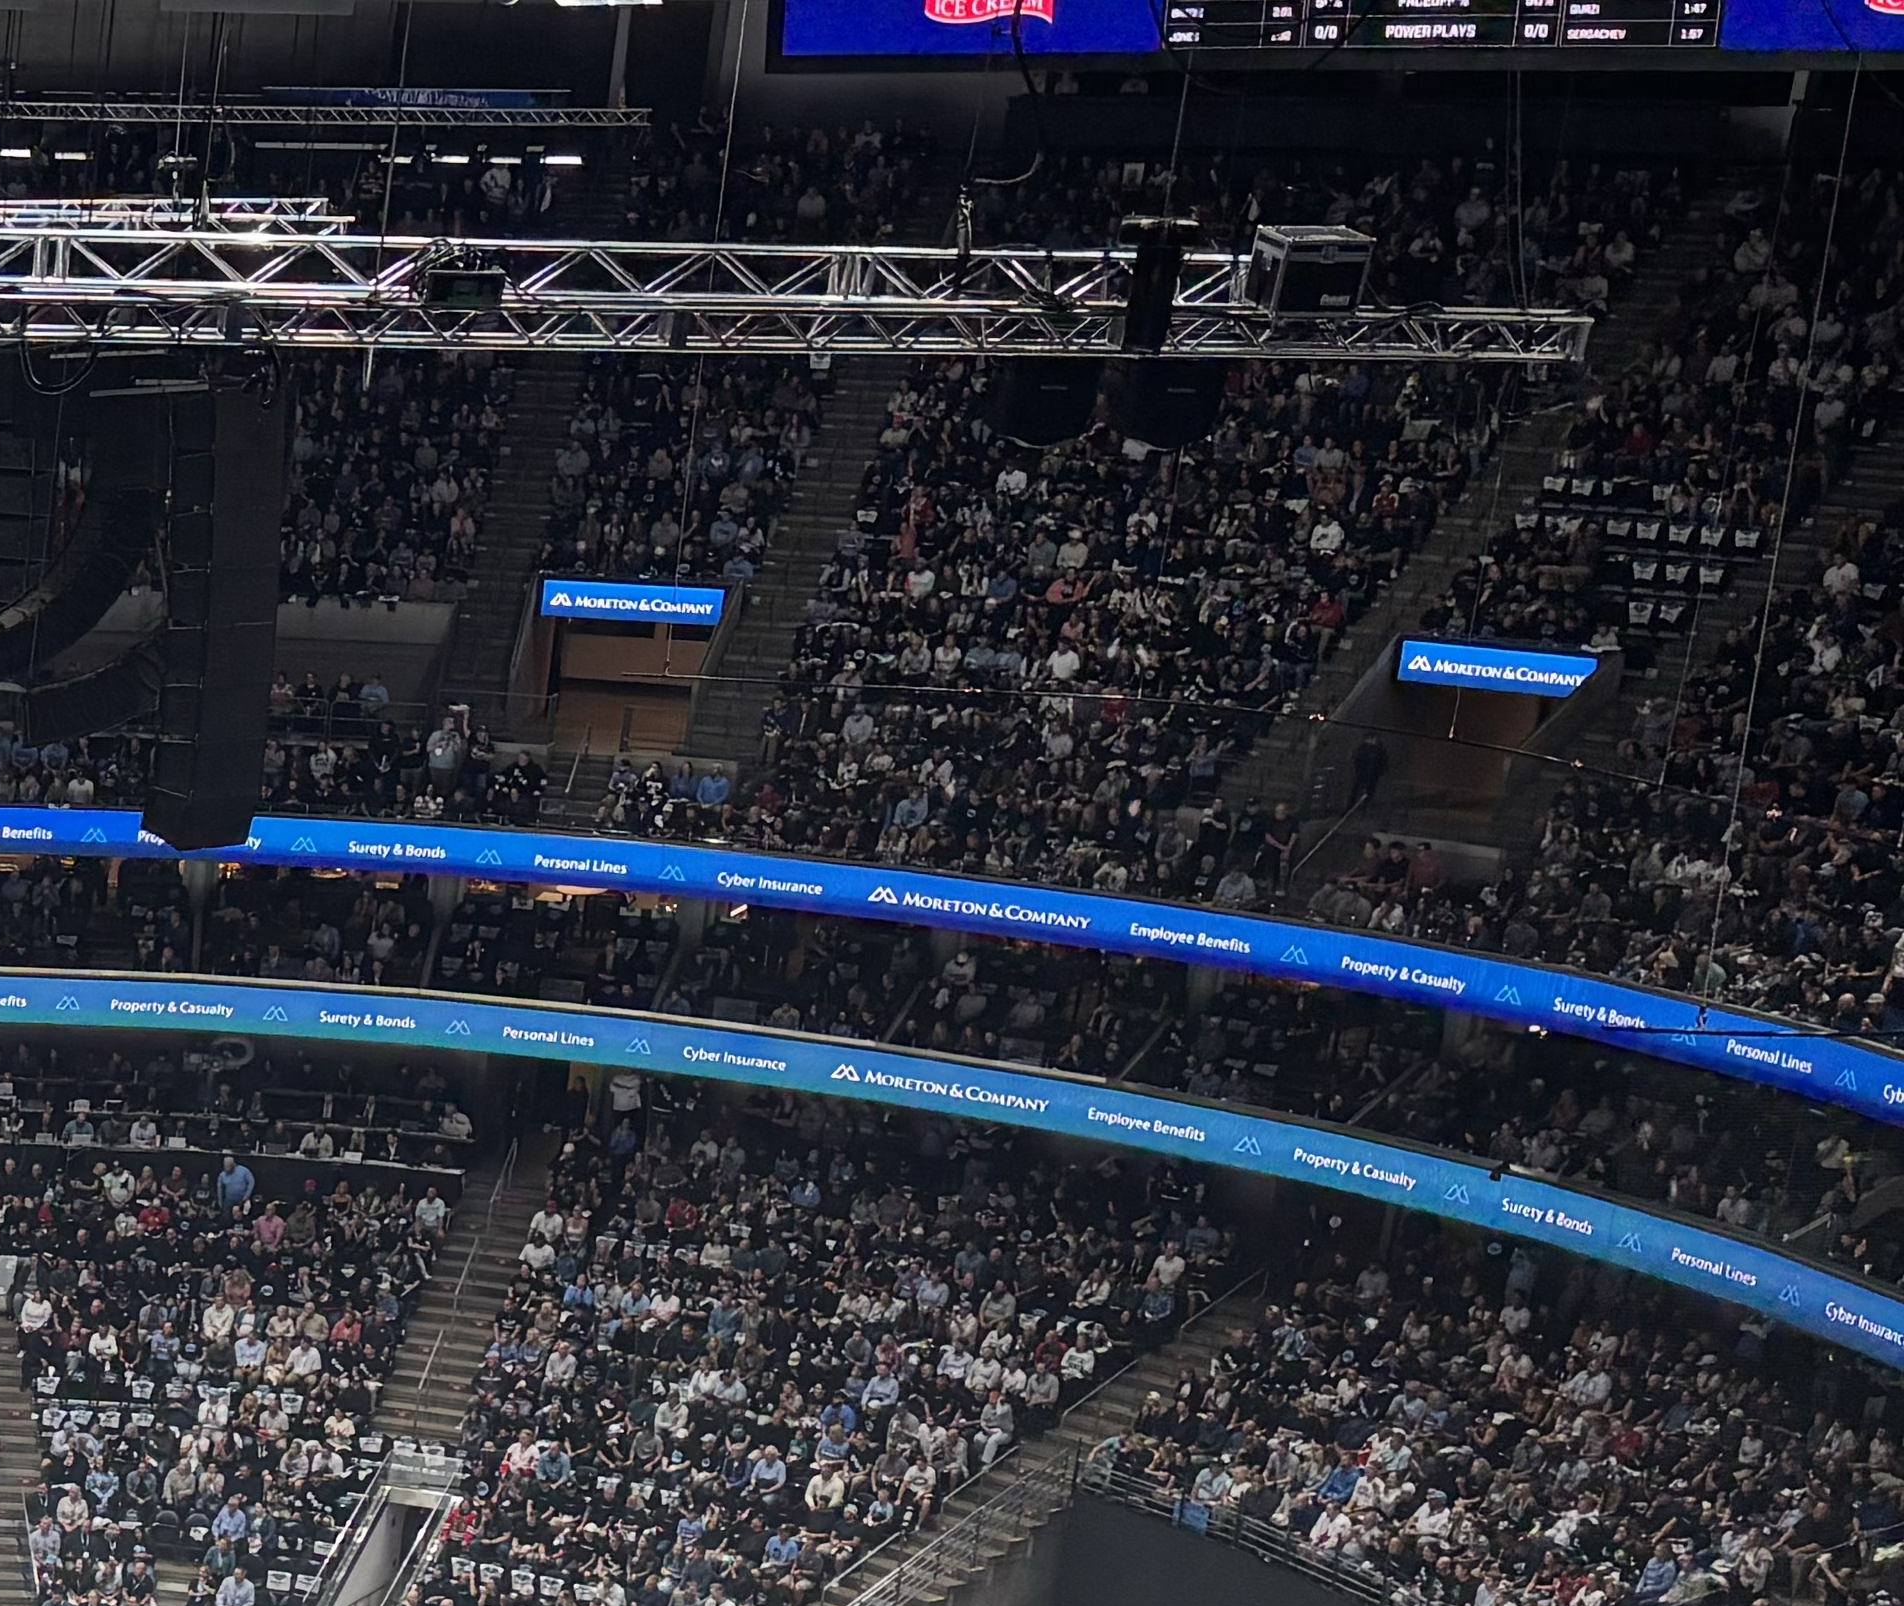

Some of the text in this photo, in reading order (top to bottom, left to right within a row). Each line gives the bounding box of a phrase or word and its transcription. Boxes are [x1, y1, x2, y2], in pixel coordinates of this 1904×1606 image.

[1314, 24, 1337, 41] 0/0
[1386, 22, 1476, 39] POWER PLAYS
[1524, 24, 1548, 40] 0/0
[534, 854, 628, 875] Personal Lines
[717, 871, 823, 896] Cyber Insurance
[1341, 956, 1466, 995] Property & Casualty
[110, 998, 234, 1018] Property & Casualty
[1553, 997, 1646, 1029] Surety & Bonds
[319, 1011, 416, 1029] Surety & Bonds
[502, 1026, 594, 1047] Personal Lines
[683, 1046, 786, 1072] Cyber Insurance
[1726, 1039, 1813, 1075] Personal Lines
[1672, 1247, 1758, 1288] Personal Lines
